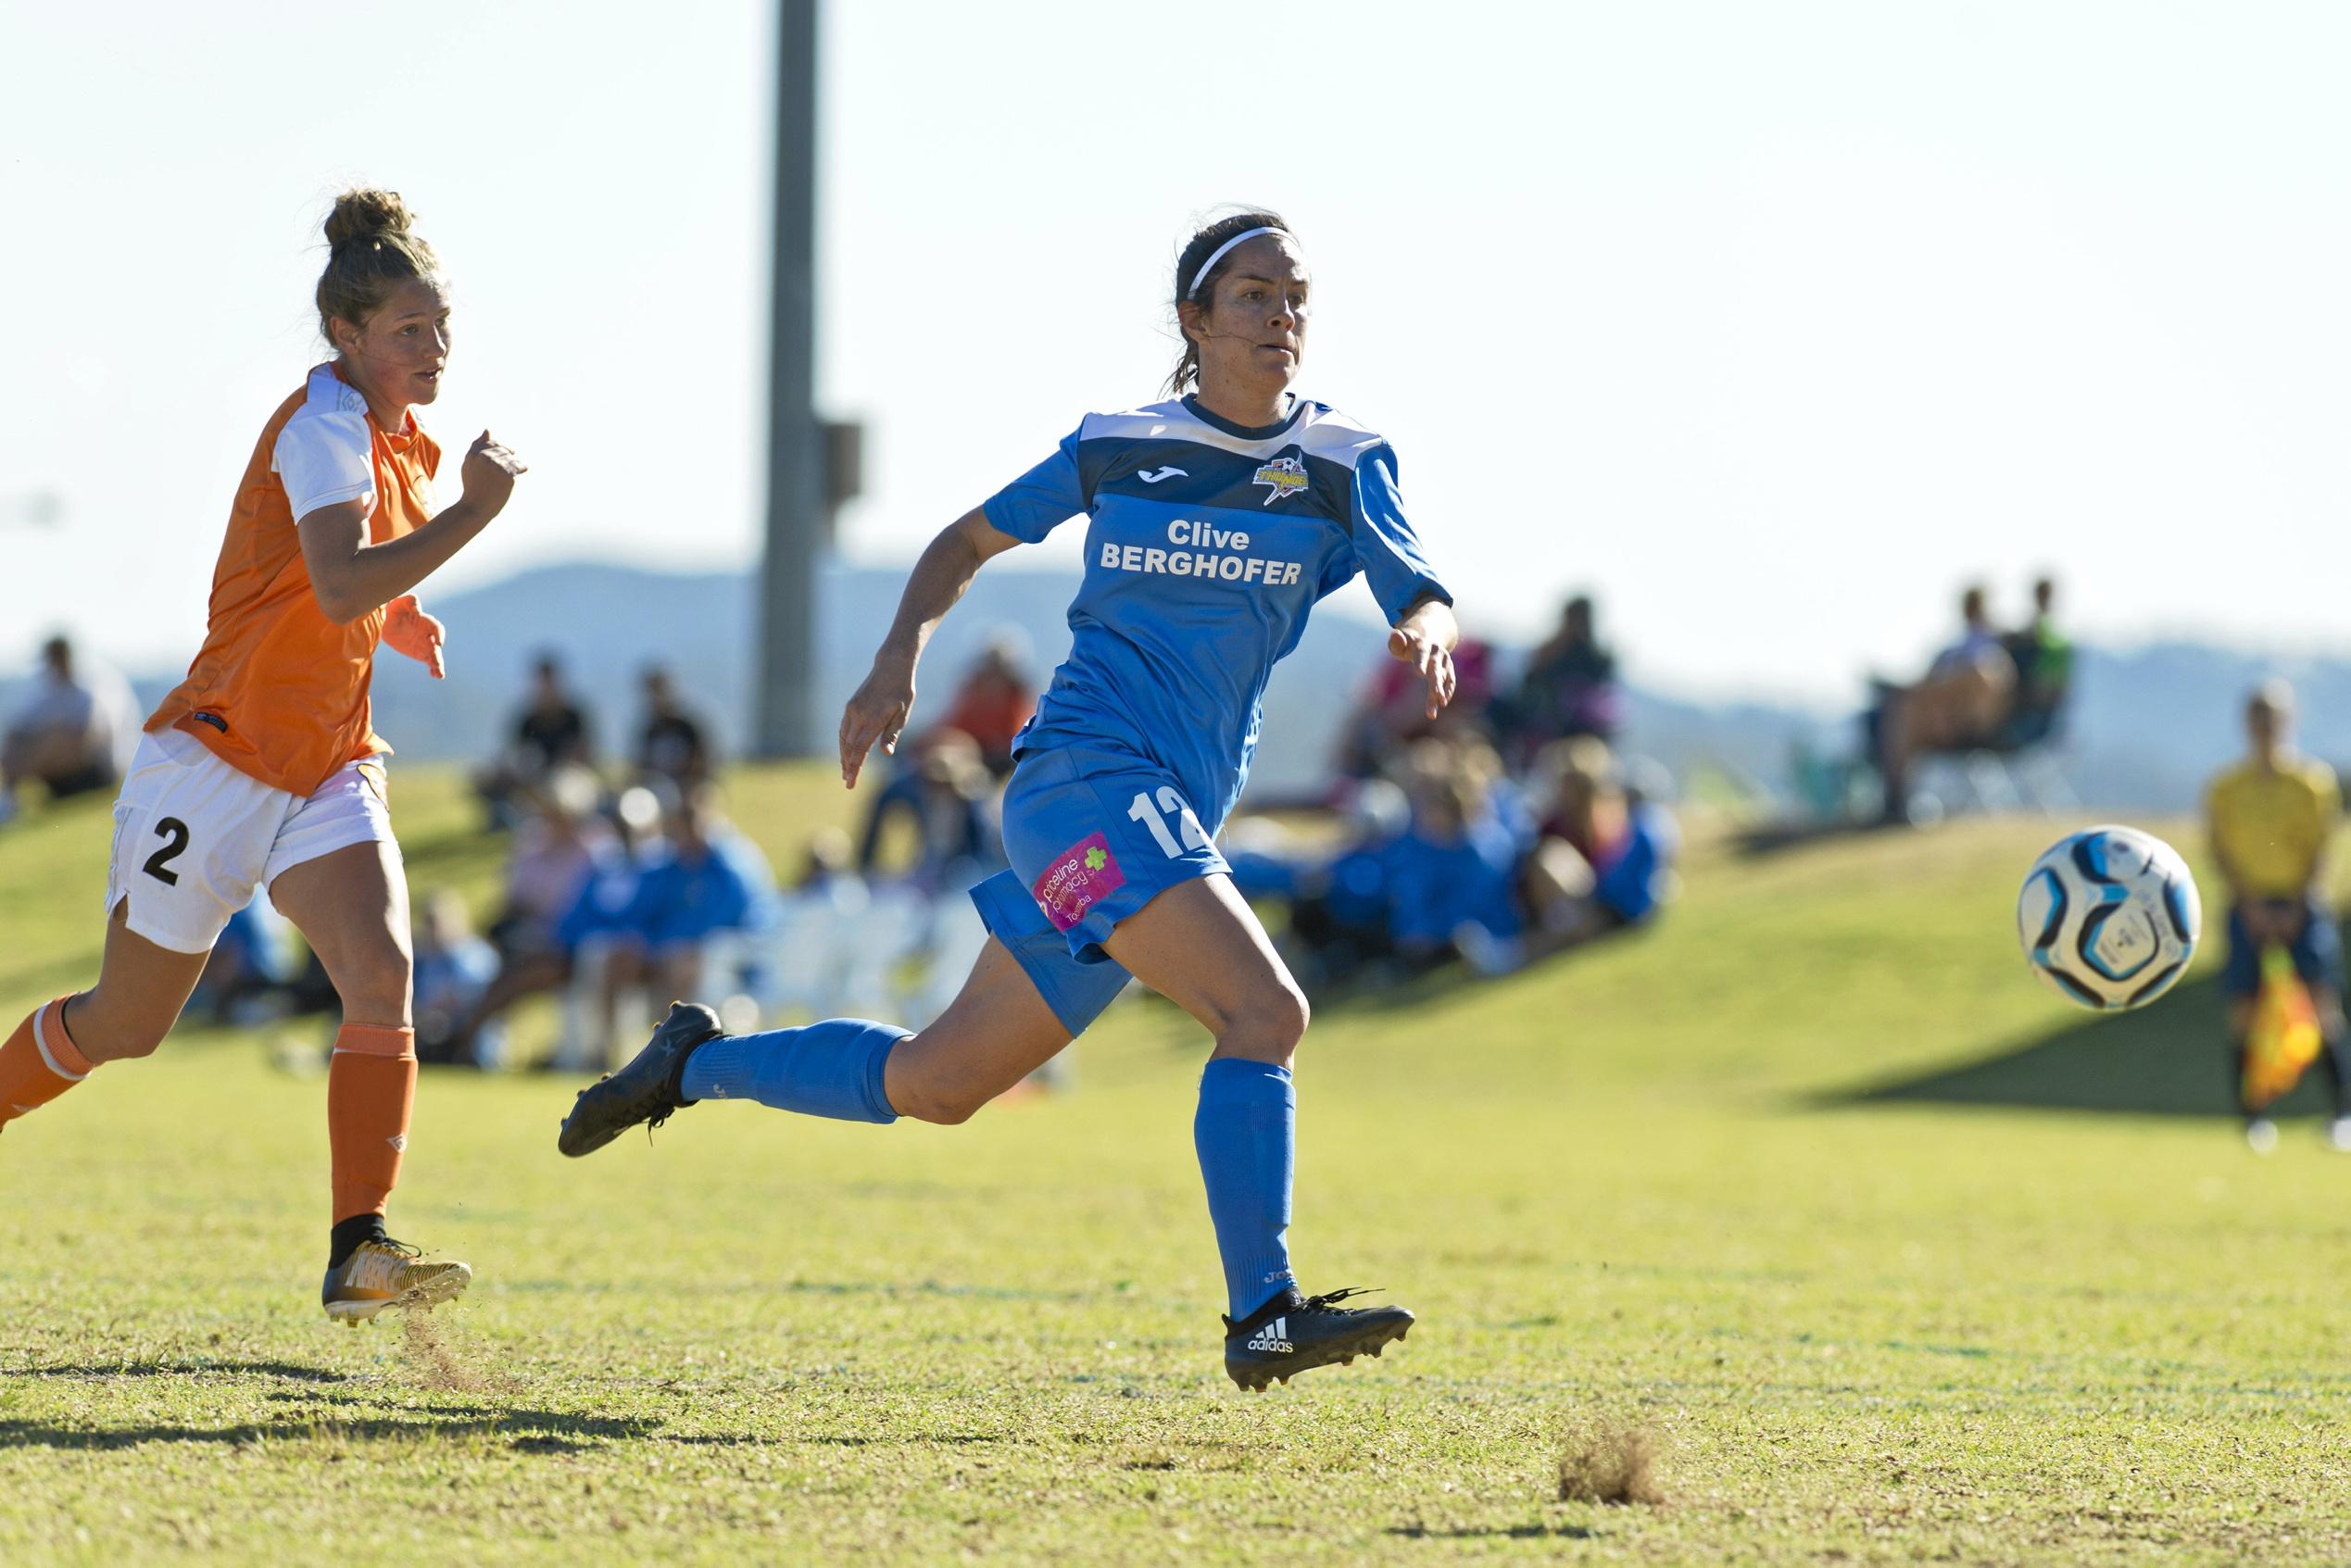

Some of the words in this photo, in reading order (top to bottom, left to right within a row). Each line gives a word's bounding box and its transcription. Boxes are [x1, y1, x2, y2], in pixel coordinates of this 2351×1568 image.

[1167, 520, 1250, 550] Clive
[1100, 543, 1301, 585] BERGHOFER
[1127, 786, 1208, 859] 12
[143, 817, 190, 886] 2
[1248, 1339, 1294, 1353] adidas
